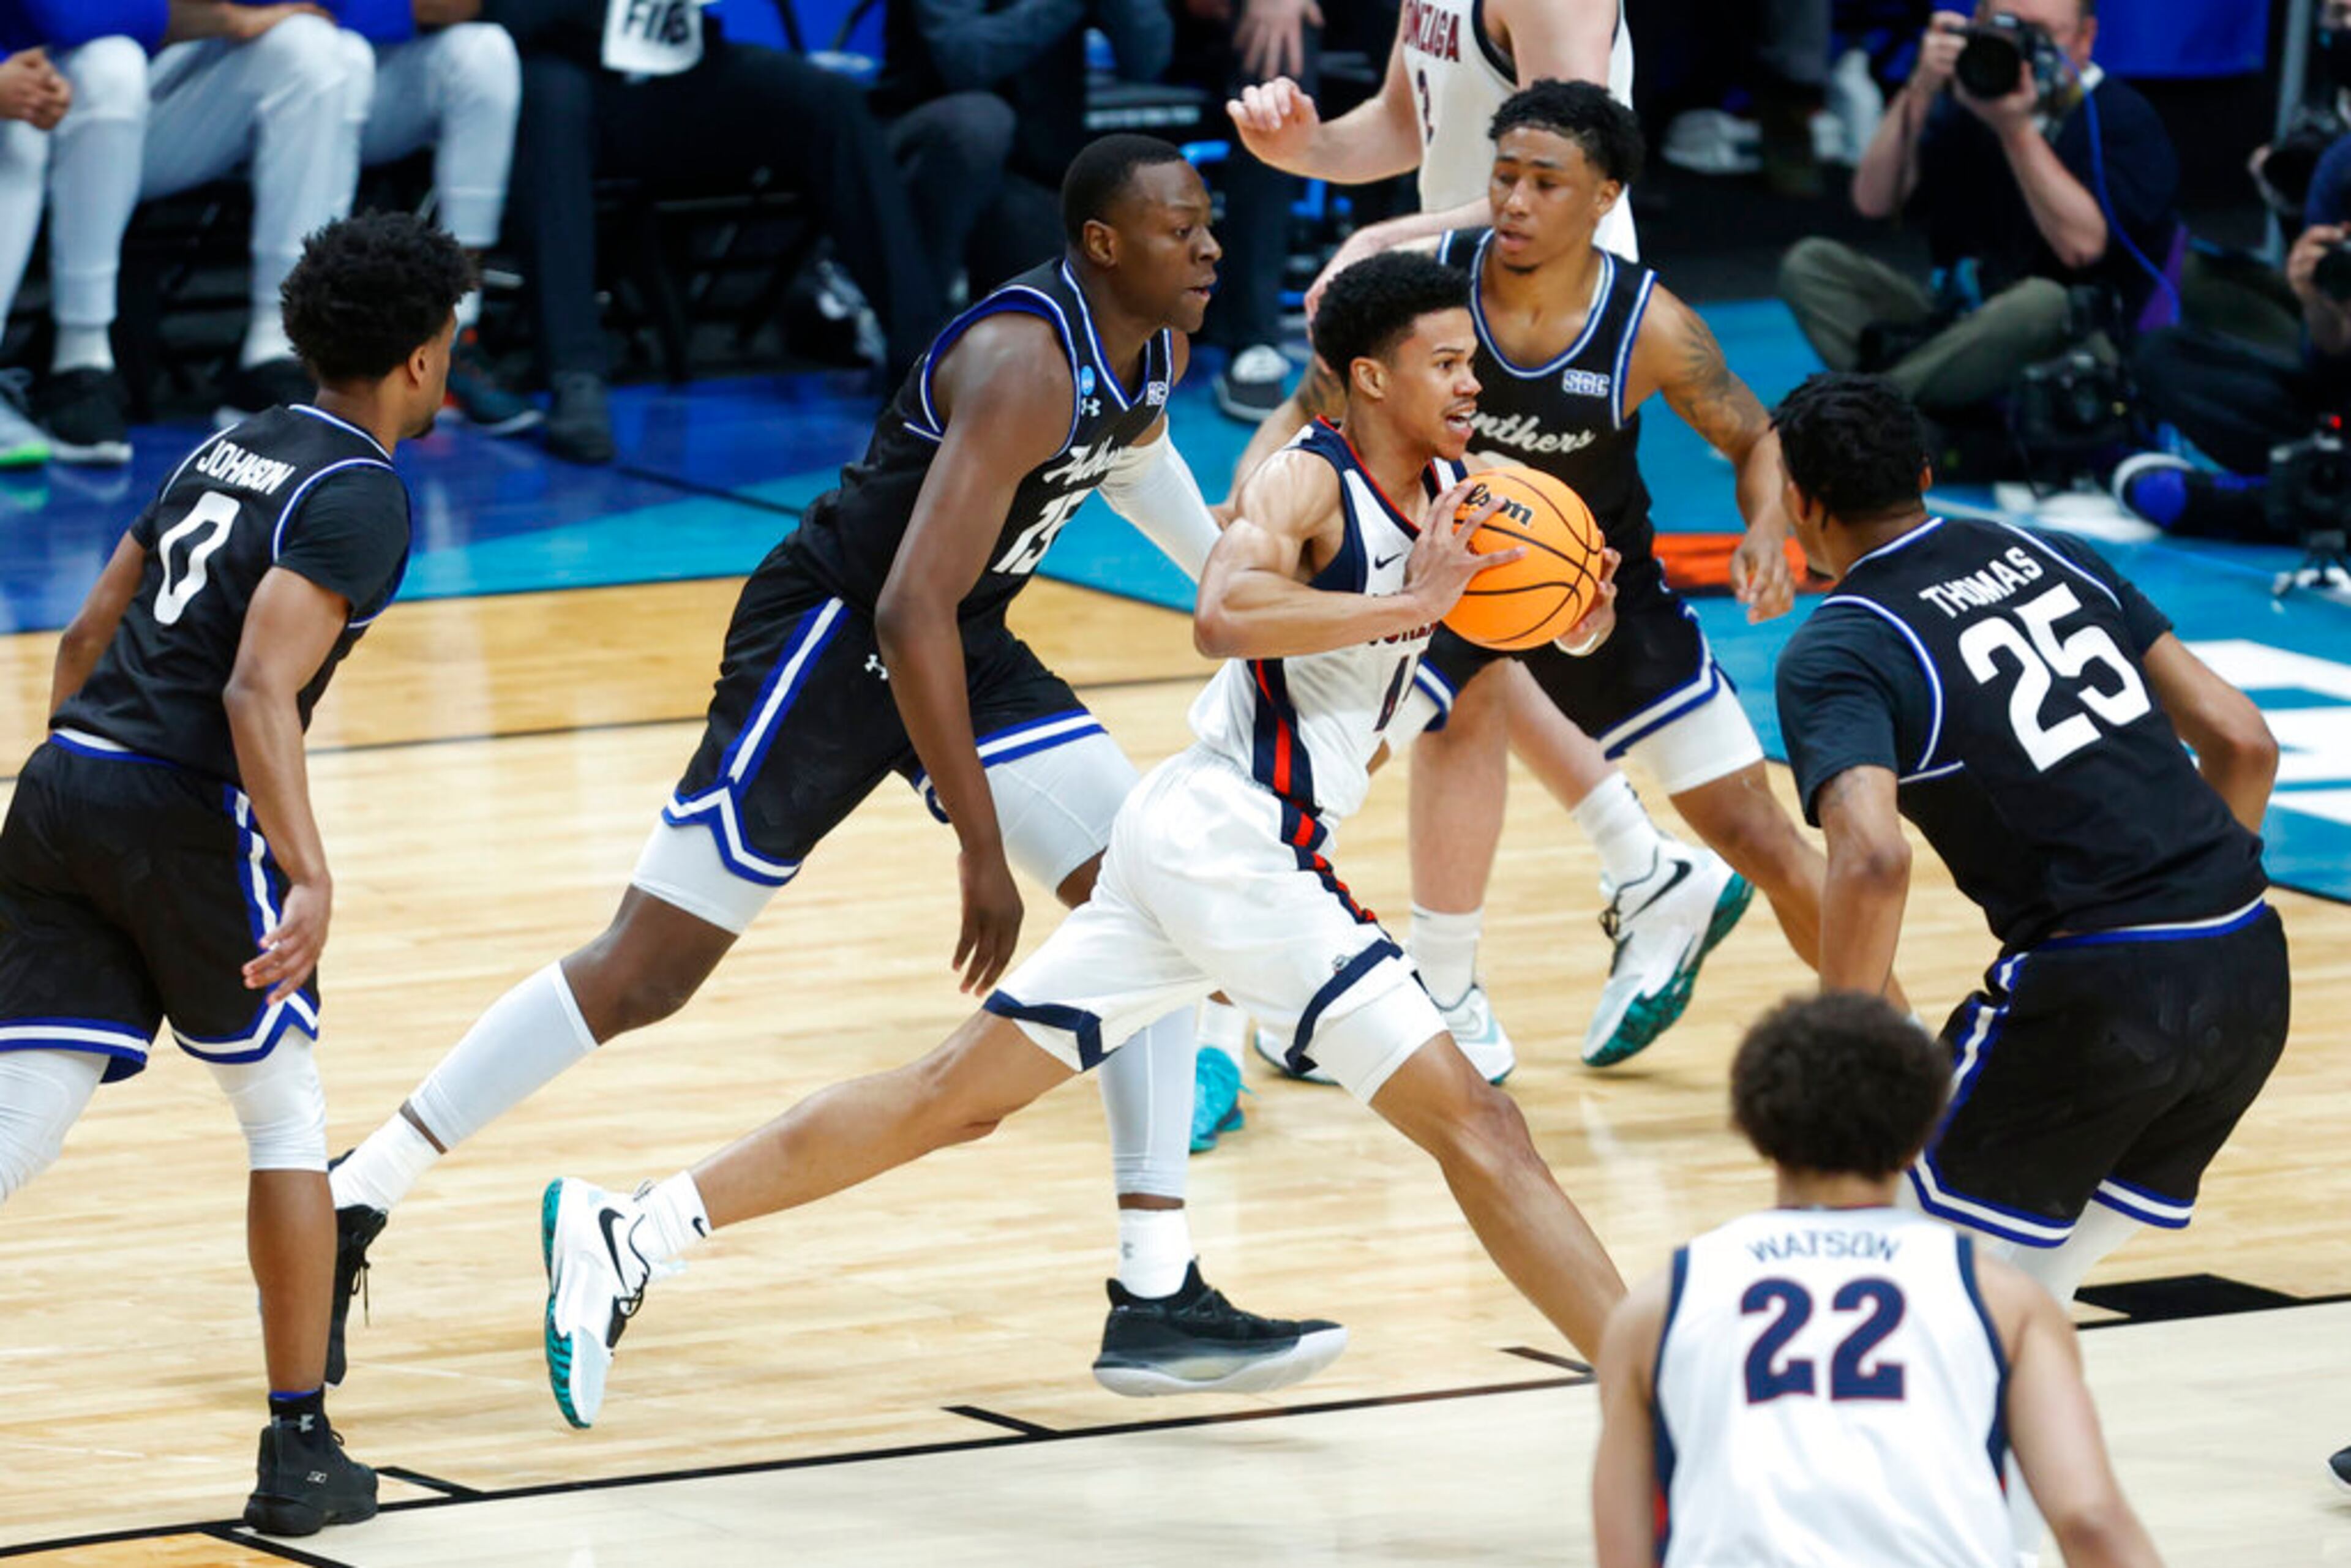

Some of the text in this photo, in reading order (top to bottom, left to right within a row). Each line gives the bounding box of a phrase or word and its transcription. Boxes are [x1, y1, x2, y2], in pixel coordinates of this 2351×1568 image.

[196, 439, 297, 495] JOHNSON
[1469, 413, 1596, 453] nthers
[154, 491, 241, 625] 0
[1918, 547, 2044, 618] THOMAS
[1959, 582, 2152, 773] 25
[1744, 1229, 1902, 1263] WATSON
[1739, 1277, 1907, 1406] 22
